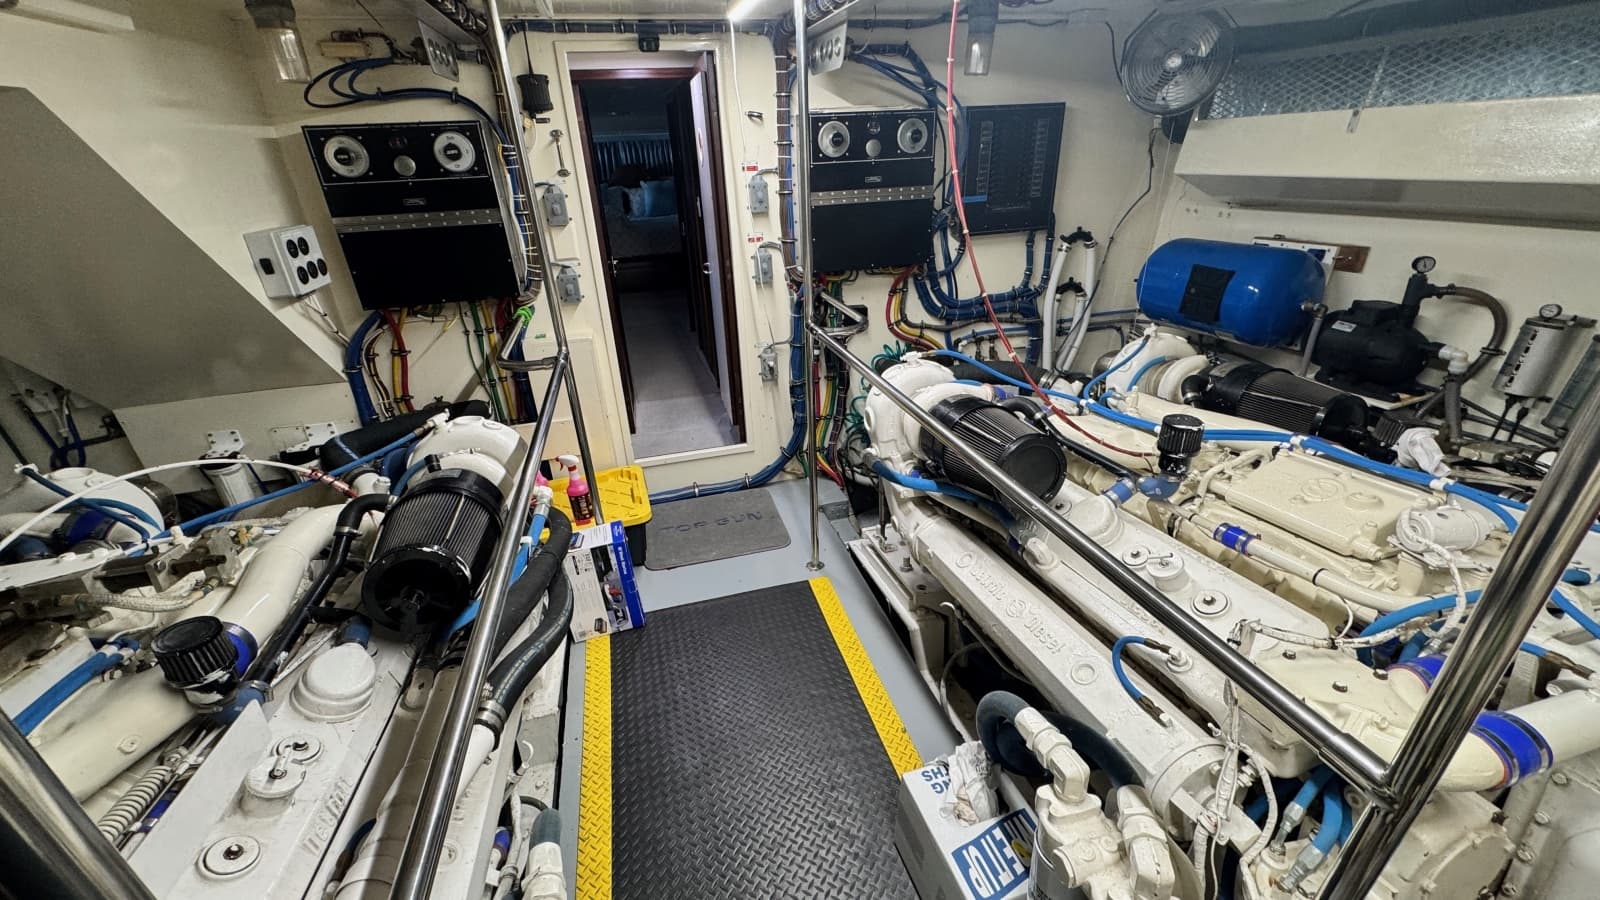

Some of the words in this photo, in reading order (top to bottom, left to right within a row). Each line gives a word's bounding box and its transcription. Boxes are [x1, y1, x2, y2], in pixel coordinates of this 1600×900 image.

[659, 521, 706, 534] TOP
[715, 511, 762, 525] GUN
[962, 845, 1001, 898] UP
[981, 835, 1015, 887] IT
